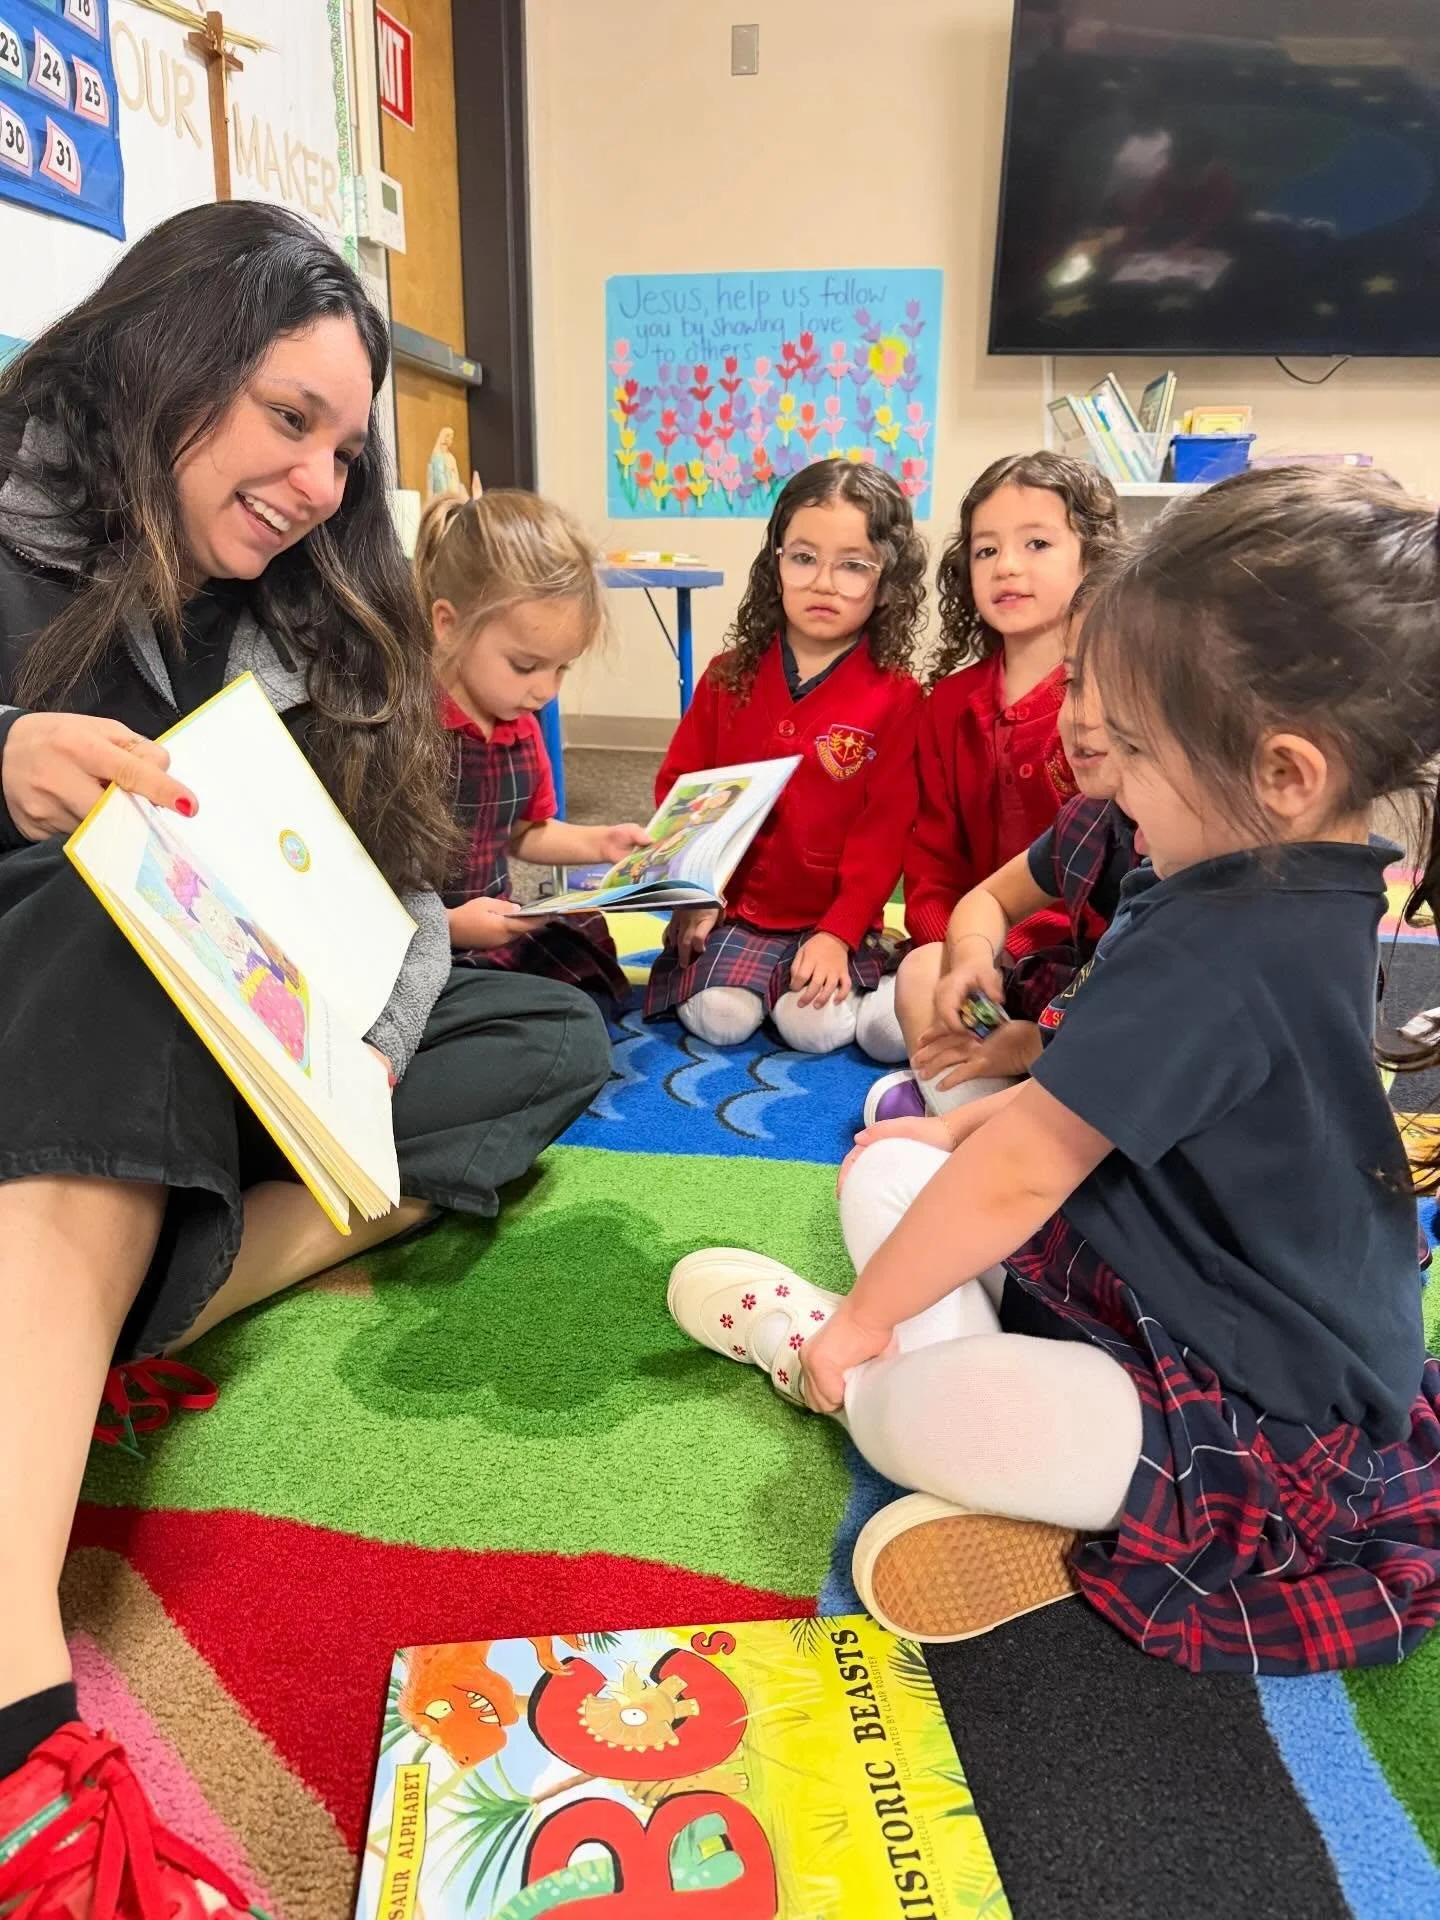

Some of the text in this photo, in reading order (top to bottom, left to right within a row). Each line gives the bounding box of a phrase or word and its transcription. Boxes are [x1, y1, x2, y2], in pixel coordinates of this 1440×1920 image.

[0, 32, 101, 107] 23 24 25
[5, 120, 72, 172] 30 31
[111, 20, 342, 229] OUR MAKER
[619, 275, 887, 321] Jesus, help us follow
[633, 311, 843, 359] you by showing love
[651, 344, 675, 365] to
[830, 1629, 887, 1744] BEASTS
[889, 1726, 912, 1780] ILLUSTRATED
[388, 1771, 420, 1920] SAUR ALPHABET
